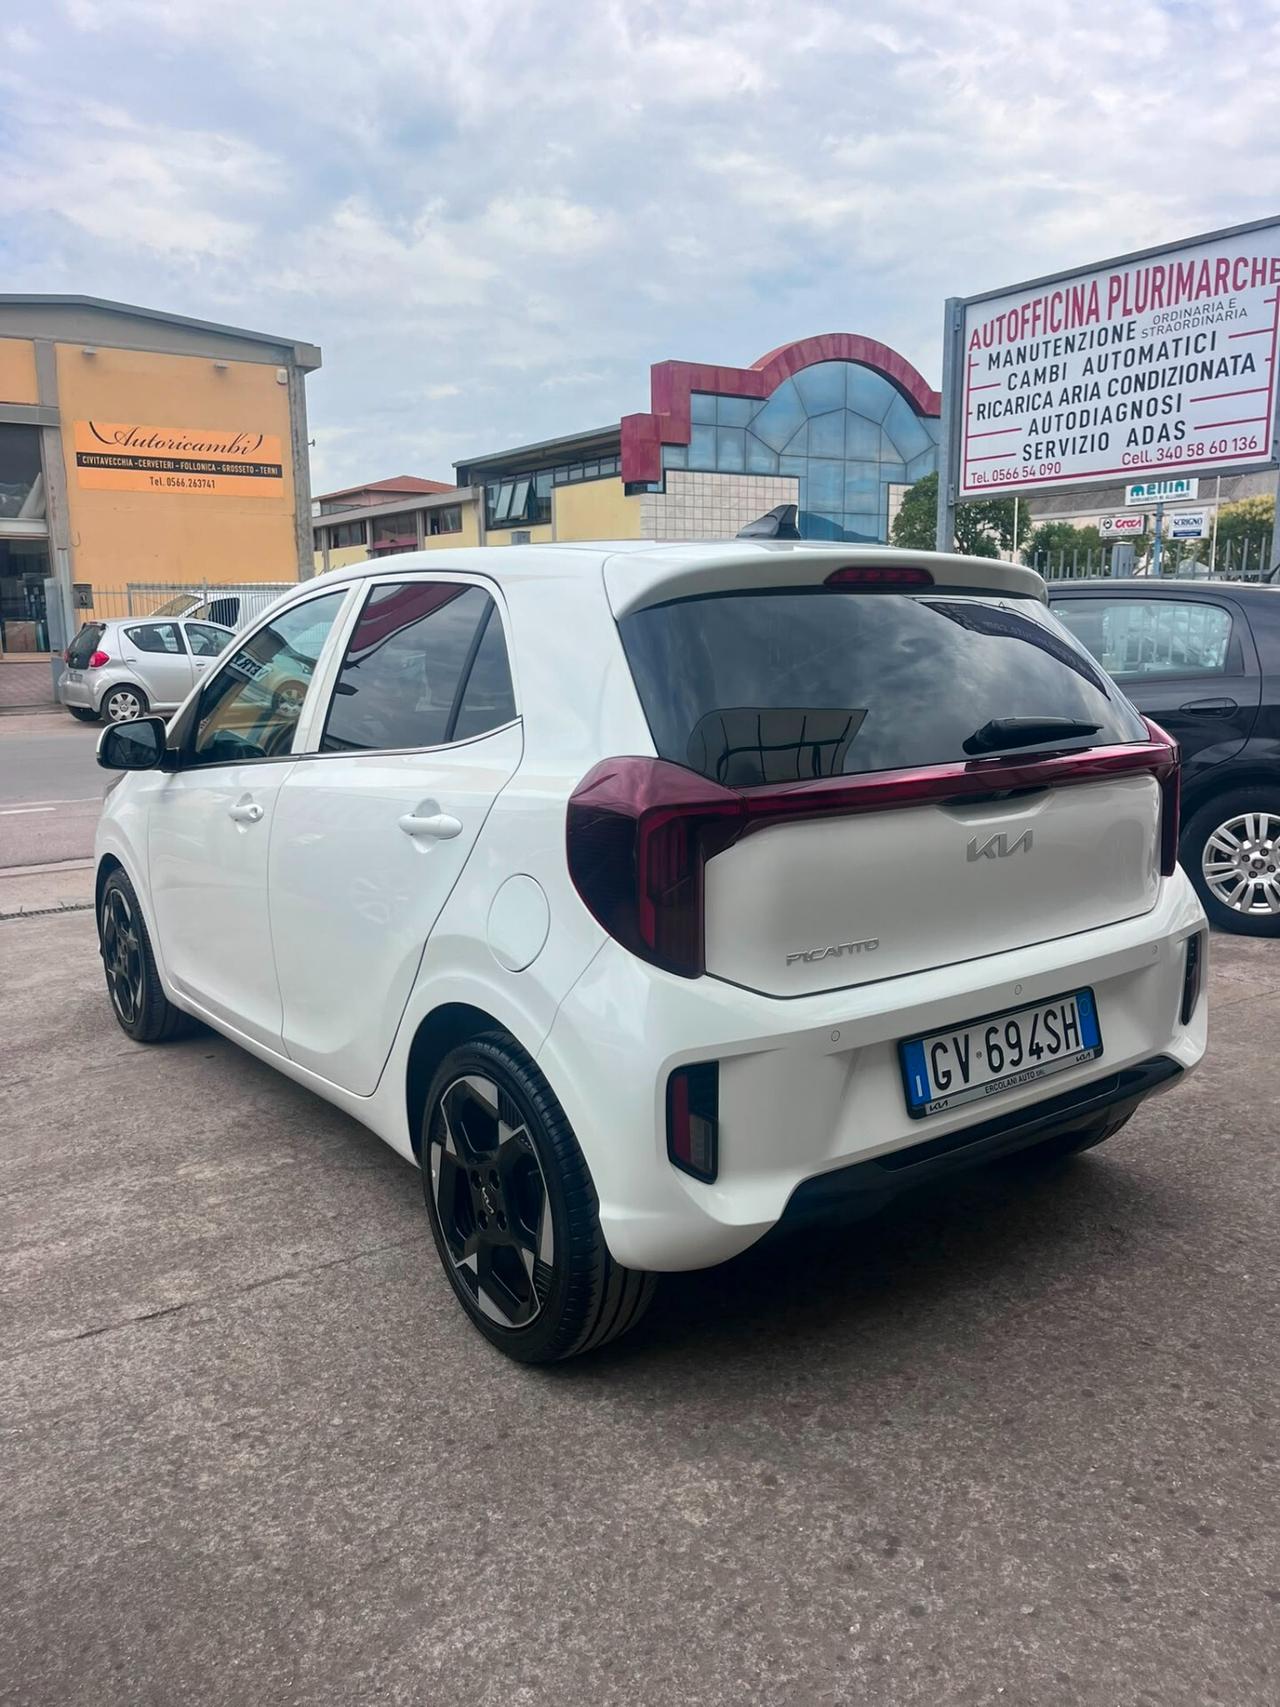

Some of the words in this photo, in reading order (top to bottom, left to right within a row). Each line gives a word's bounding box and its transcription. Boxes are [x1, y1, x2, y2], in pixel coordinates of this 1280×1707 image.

[969, 280, 1100, 351] AUTOFFICINA
[1107, 256, 1280, 320] PLURIMARCHE
[1153, 301, 1224, 325] ORDINARIA
[1229, 298, 1237, 309] E
[1141, 307, 1248, 339] STRAORDINARIA
[988, 321, 1137, 370] MANUTENZIONE
[1008, 362, 1067, 391] CAMBI
[1082, 330, 1217, 376] AUTOMATICI
[977, 390, 1053, 421] RICARICA
[1059, 382, 1101, 407] ARIA
[1107, 352, 1256, 398] CONDIZIONATA
[1028, 393, 1182, 436] AUTODIAGNOSI
[89, 421, 263, 455] Autoricambi
[1022, 432, 1109, 461] SERVIZIO
[1126, 421, 1186, 447] ADAS
[1122, 451, 1151, 466] Cell.
[1157, 447, 1182, 461] 340
[1187, 443, 1204, 458] 58
[1209, 440, 1227, 454] 60
[1232, 436, 1258, 451] 136
[971, 471, 989, 484] Tel.
[992, 467, 1019, 481] 0566
[1022, 465, 1036, 479] 54
[1039, 462, 1061, 476] 090
[786, 938, 880, 966] PICANTO
[931, 1034, 970, 1091] GV
[985, 1002, 1081, 1074] 694SH
[985, 1078, 1018, 1094] ERCOLANI
[1018, 1070, 1036, 1083] AUTO
